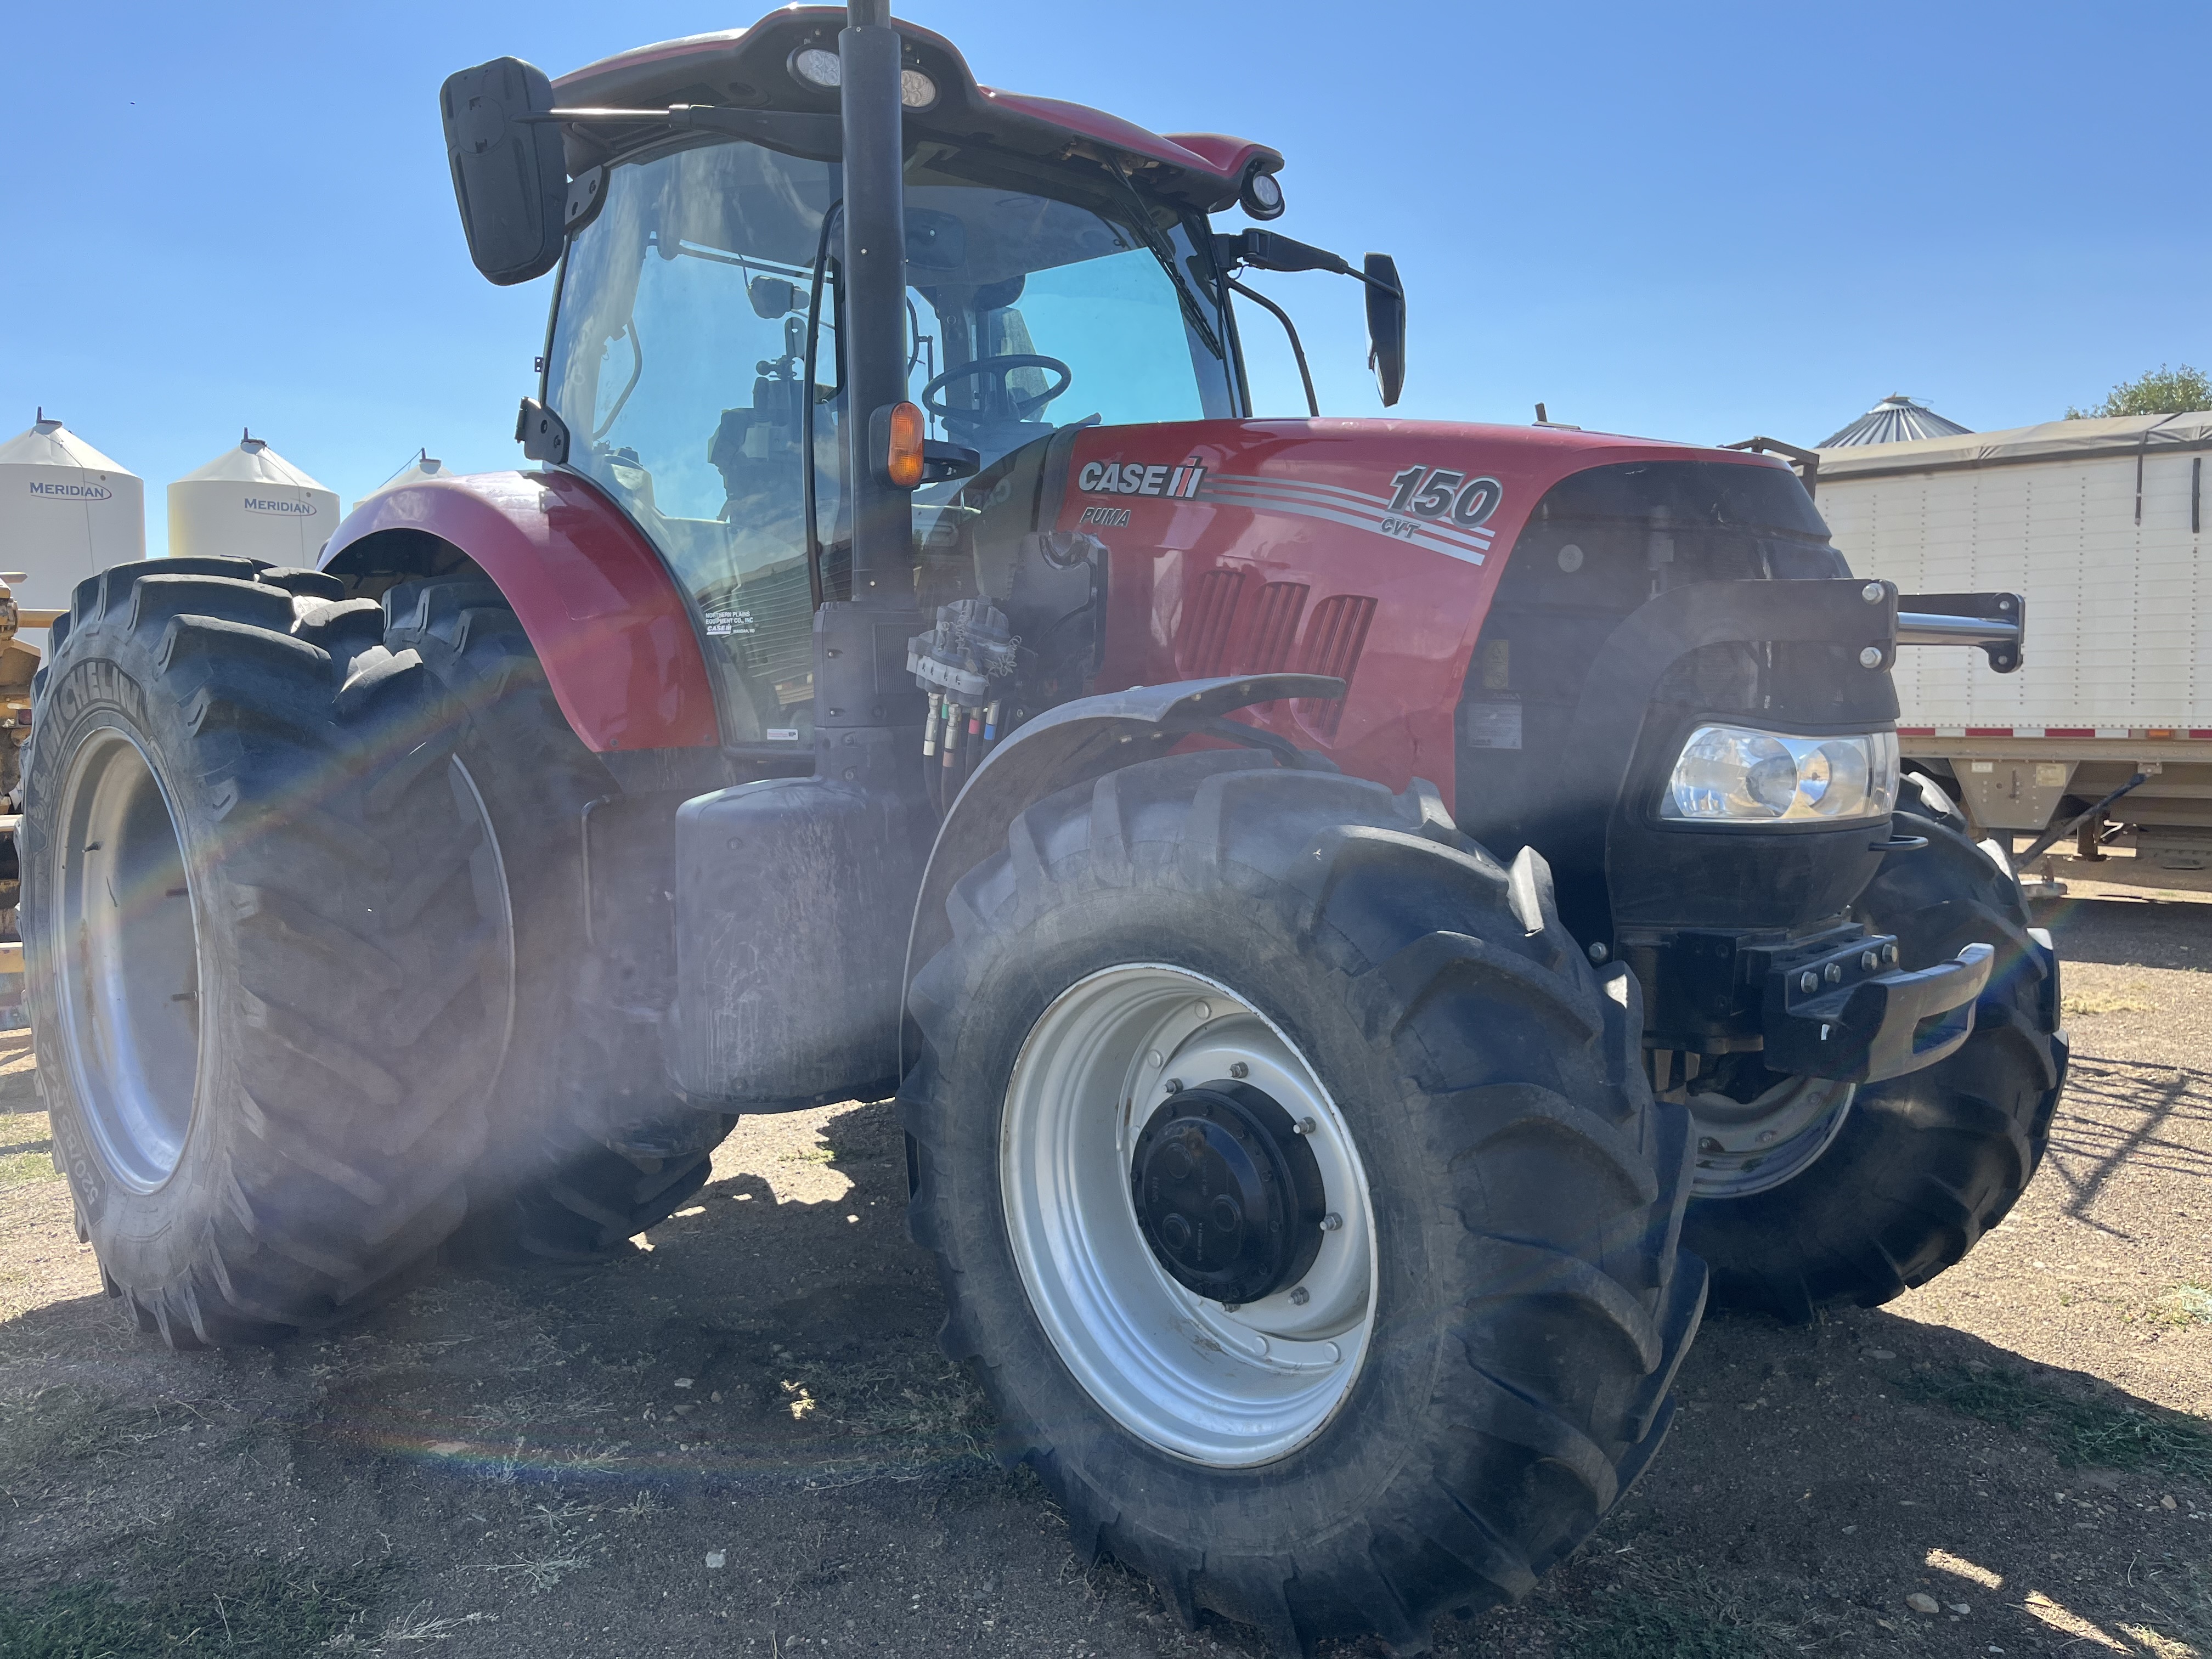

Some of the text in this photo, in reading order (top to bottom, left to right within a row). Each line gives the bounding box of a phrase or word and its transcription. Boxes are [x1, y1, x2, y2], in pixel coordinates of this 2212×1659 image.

[30, 482, 104, 498] MERIDIAN
[1079, 462, 1168, 495] CASE
[244, 498, 310, 514] MERIDIAN
[1385, 463, 1503, 529] 150
[1080, 507, 1131, 527] PUMA
[1380, 516, 1421, 539] CVT
[38, 661, 140, 772] MICHELIN
